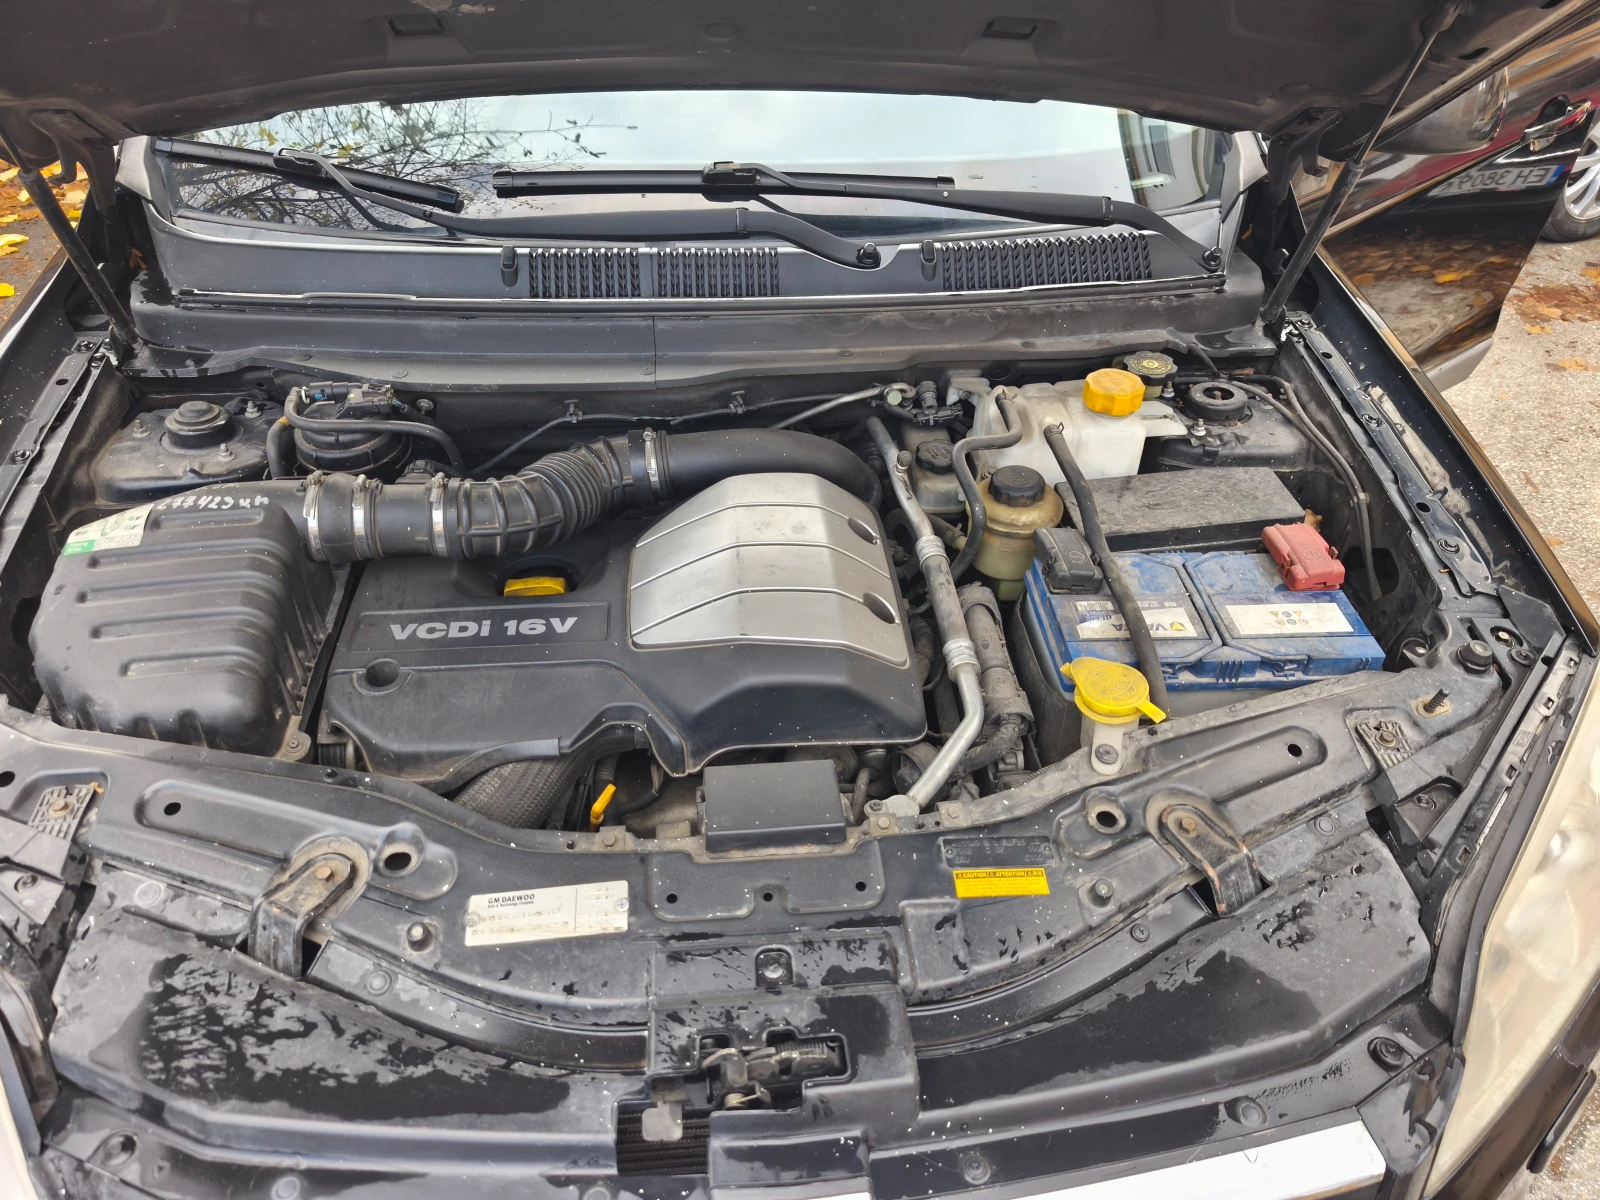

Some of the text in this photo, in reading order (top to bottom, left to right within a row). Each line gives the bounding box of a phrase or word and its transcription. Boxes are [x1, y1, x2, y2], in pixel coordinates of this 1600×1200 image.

[390, 616, 578, 640] VCDi 16V
[995, 870, 1025, 878] ATTENTION
[487, 893, 535, 904] GM DAEWOO
